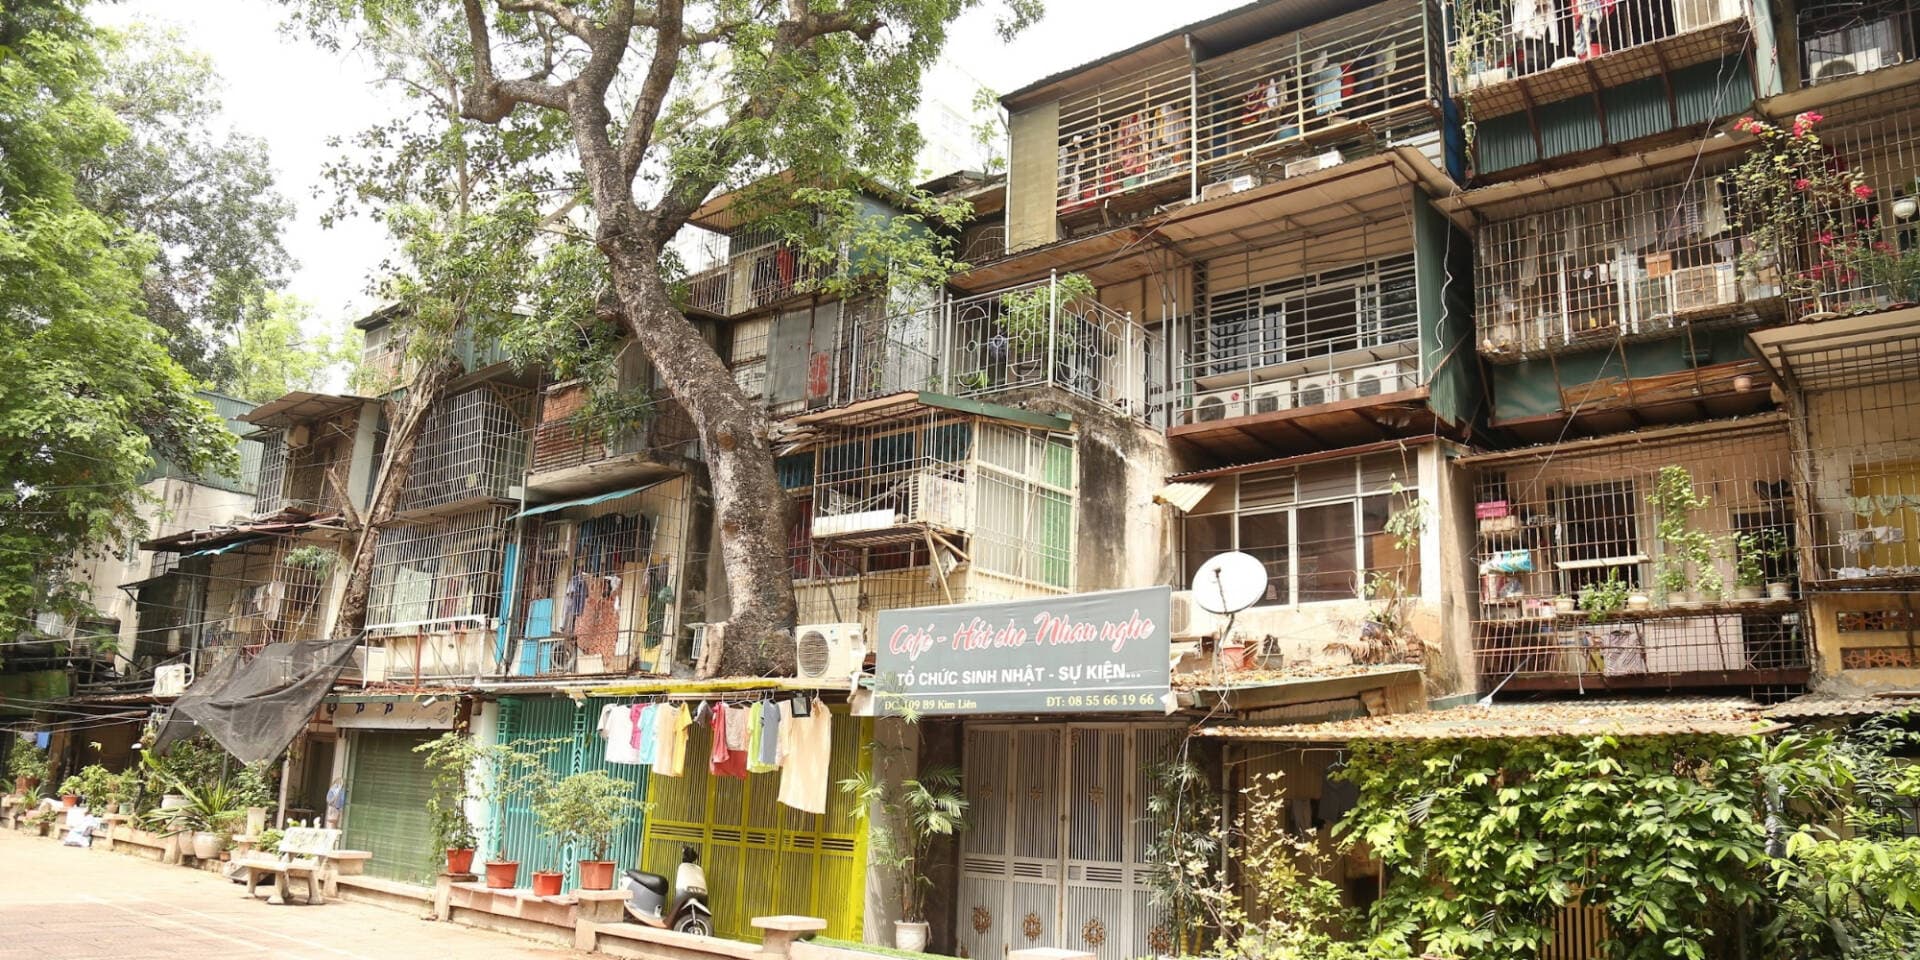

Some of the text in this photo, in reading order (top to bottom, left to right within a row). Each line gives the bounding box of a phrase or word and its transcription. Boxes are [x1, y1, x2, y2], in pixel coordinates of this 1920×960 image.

[889, 623, 935, 661] Café
[952, 616, 994, 650] Hát
[1033, 611, 1097, 646] Nhau
[1100, 608, 1155, 653] nghe
[897, 666, 914, 686] TỔ
[918, 668, 958, 685] CHỨC
[962, 669, 997, 685] SINH
[1002, 664, 1045, 687] NHẬT
[1058, 664, 1082, 685] SỰ
[938, 699, 954, 709] Kim
[958, 698, 976, 709] Liên
[1046, 693, 1154, 707] ĐT: 08 55 66 19 66
